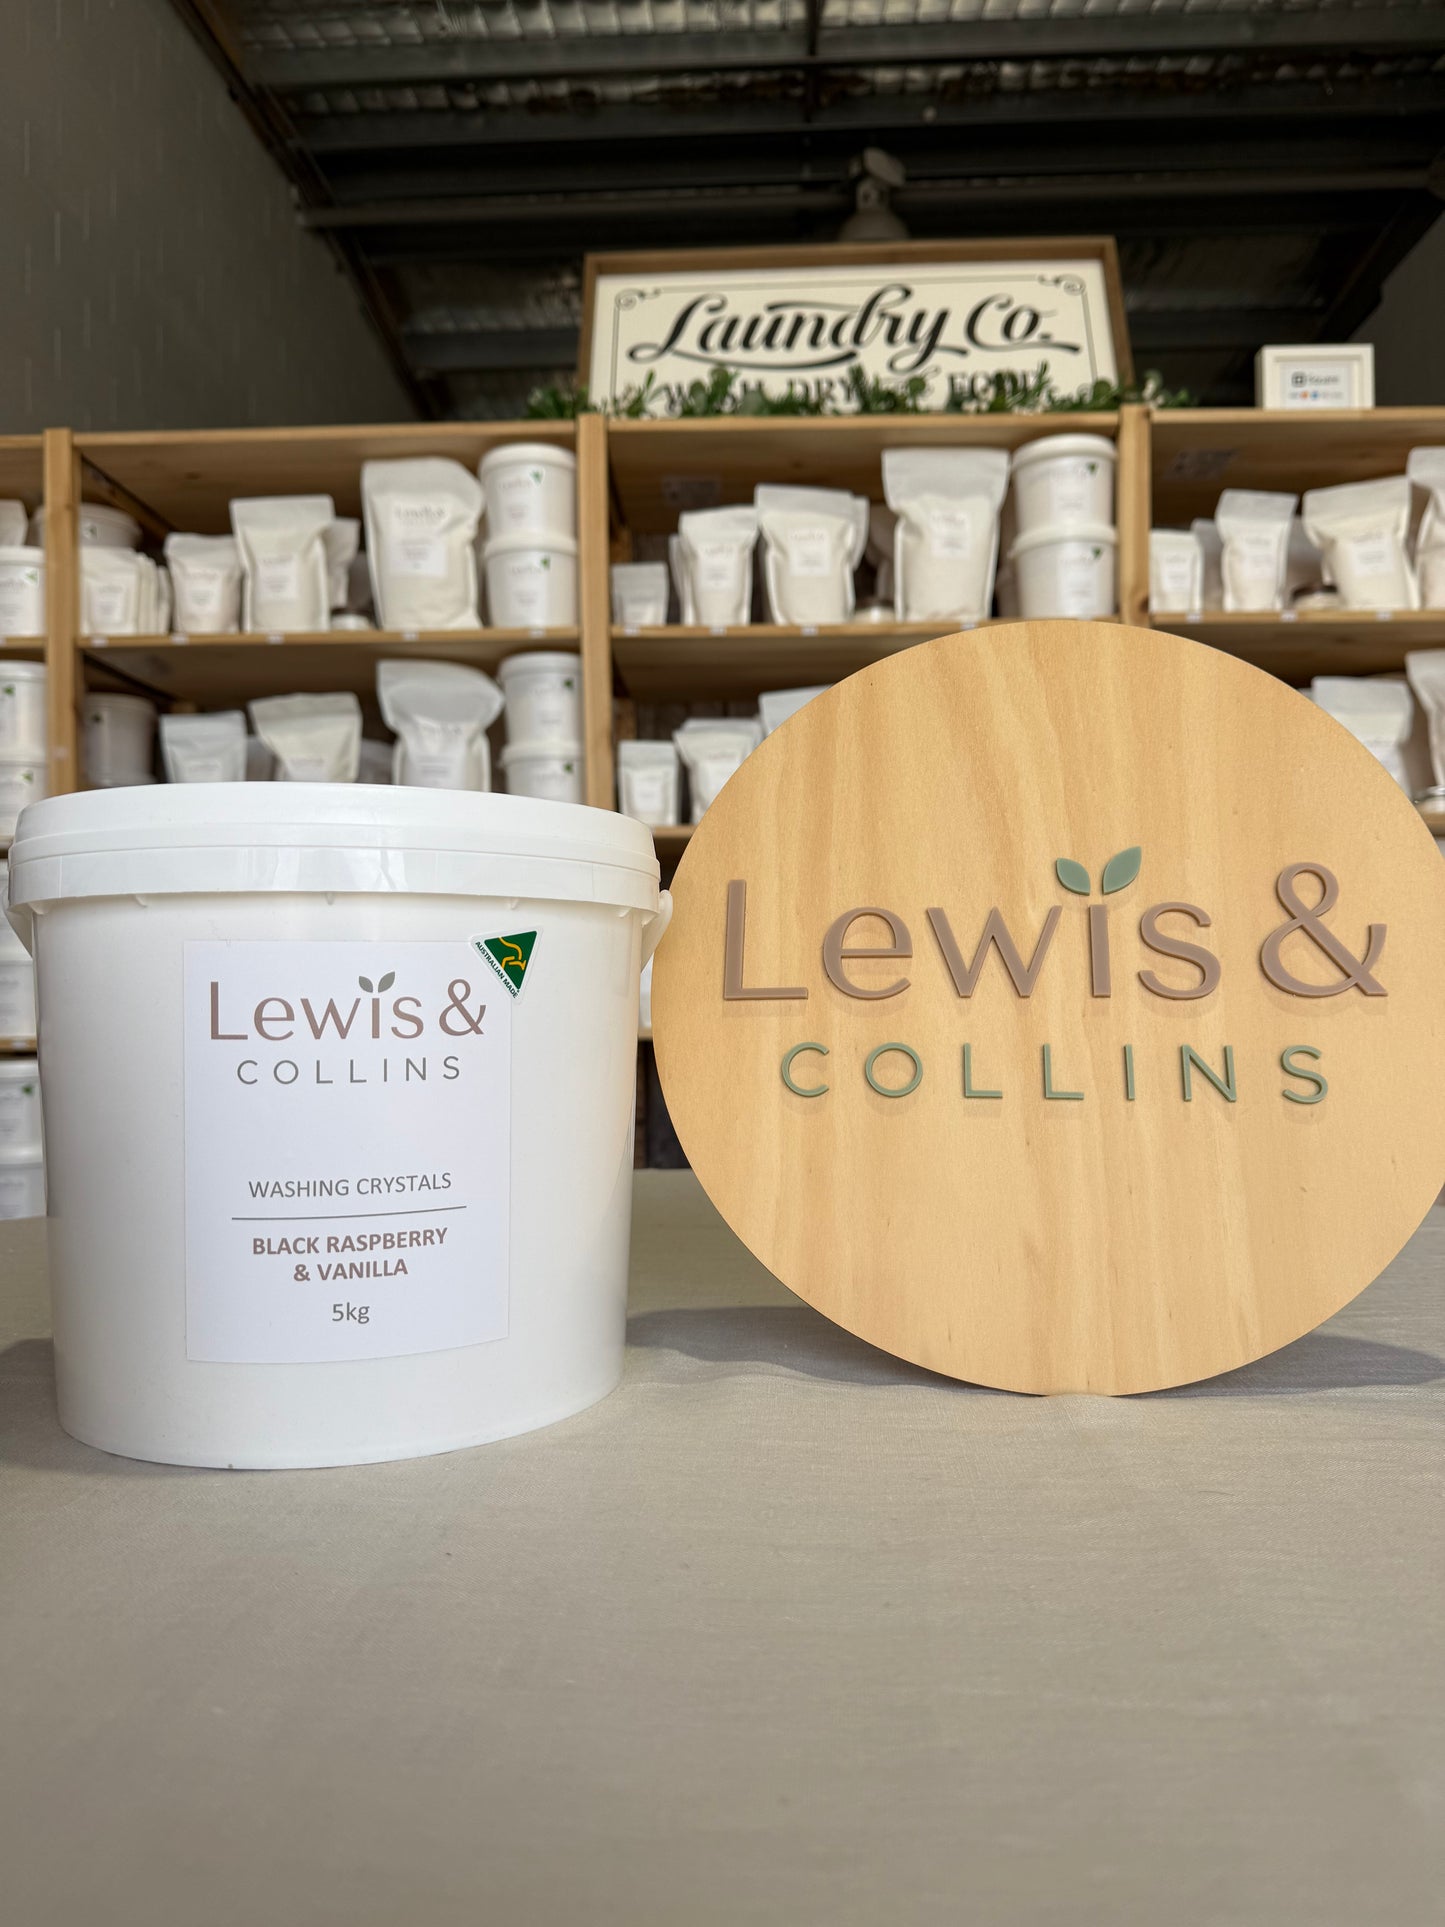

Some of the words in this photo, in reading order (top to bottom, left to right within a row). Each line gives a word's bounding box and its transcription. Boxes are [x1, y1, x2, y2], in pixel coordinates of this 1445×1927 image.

[627, 284, 968, 373] Laundry
[965, 293, 1081, 354] Co.
[724, 846, 1222, 1001] Lewis
[1258, 861, 1388, 998] &
[475, 941, 505, 980] AUSTRALIAN
[502, 978, 519, 999] MADE
[210, 971, 425, 1041] Lewis
[438, 978, 487, 1037] &
[236, 1055, 461, 1086] COLLINS
[781, 1040, 1329, 1104] COLLINS
[248, 1178, 350, 1199] WASHING
[356, 1172, 452, 1195] CRYSTALS
[252, 1235, 320, 1255] BLACK
[326, 1226, 448, 1253] RASPBERRY
[293, 1263, 311, 1282] &
[317, 1257, 409, 1281] VANILLA
[331, 1302, 371, 1325] 5kg
